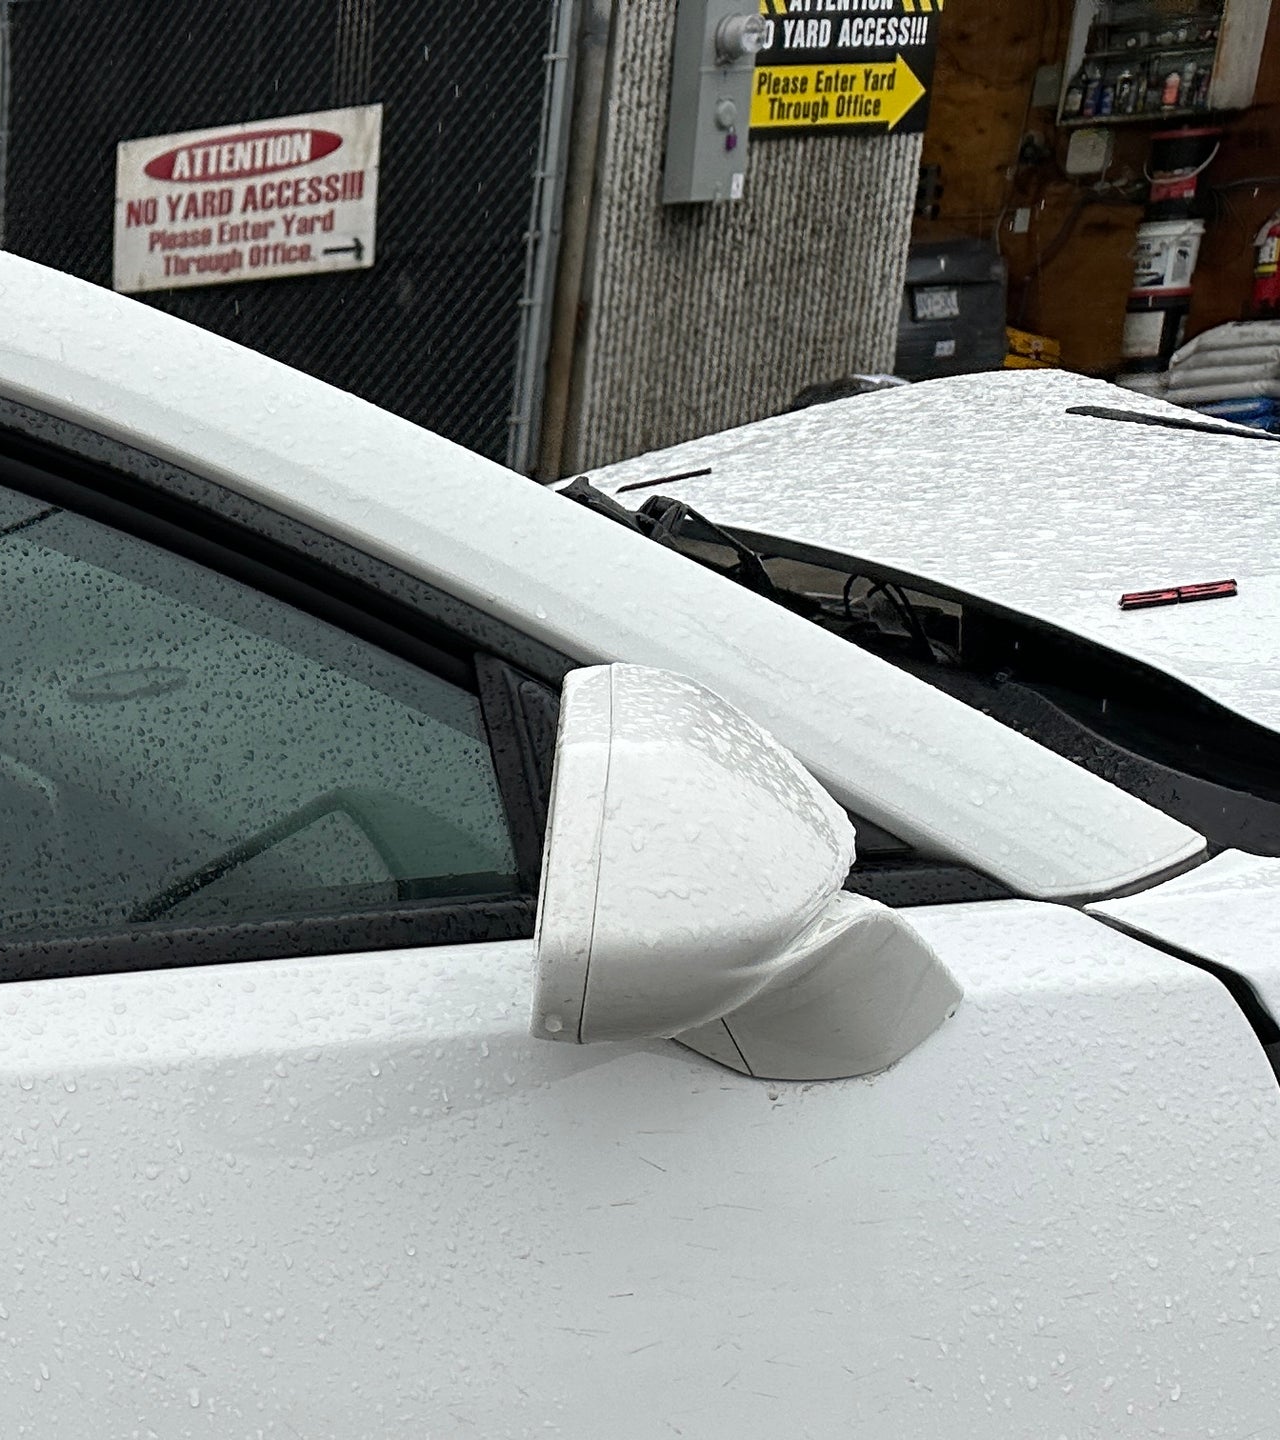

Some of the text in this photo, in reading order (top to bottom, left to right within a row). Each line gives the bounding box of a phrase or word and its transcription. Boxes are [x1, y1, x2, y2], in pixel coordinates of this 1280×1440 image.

[783, 18, 832, 49] YARD
[837, 16, 929, 48] ACCESS!!!
[757, 68, 896, 96] Please Enter Yard
[768, 95, 882, 123] Through Office
[171, 131, 312, 181] ATTENTION
[125, 170, 365, 229] NO YARD ACCESS!!!
[149, 210, 335, 252] Please Enter Yard
[163, 251, 242, 278] Through
